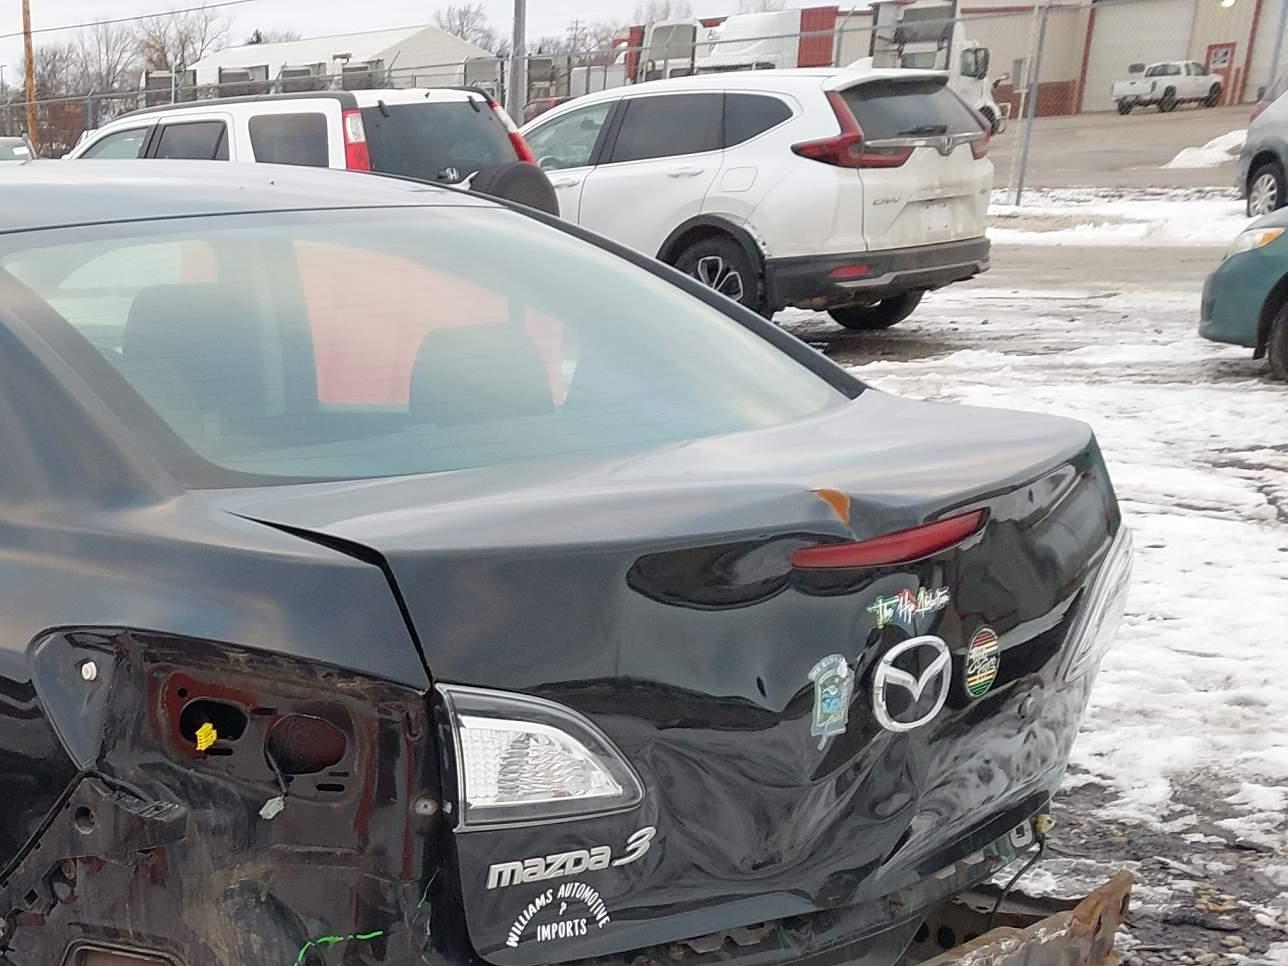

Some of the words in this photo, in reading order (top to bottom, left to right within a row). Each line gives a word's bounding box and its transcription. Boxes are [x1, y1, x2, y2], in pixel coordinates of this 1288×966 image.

[612, 826, 657, 867] 3
[506, 888, 554, 948] WILLIAMS
[557, 881, 611, 929] AUTOMOTIVE
[537, 918, 587, 942] IMPORTS
